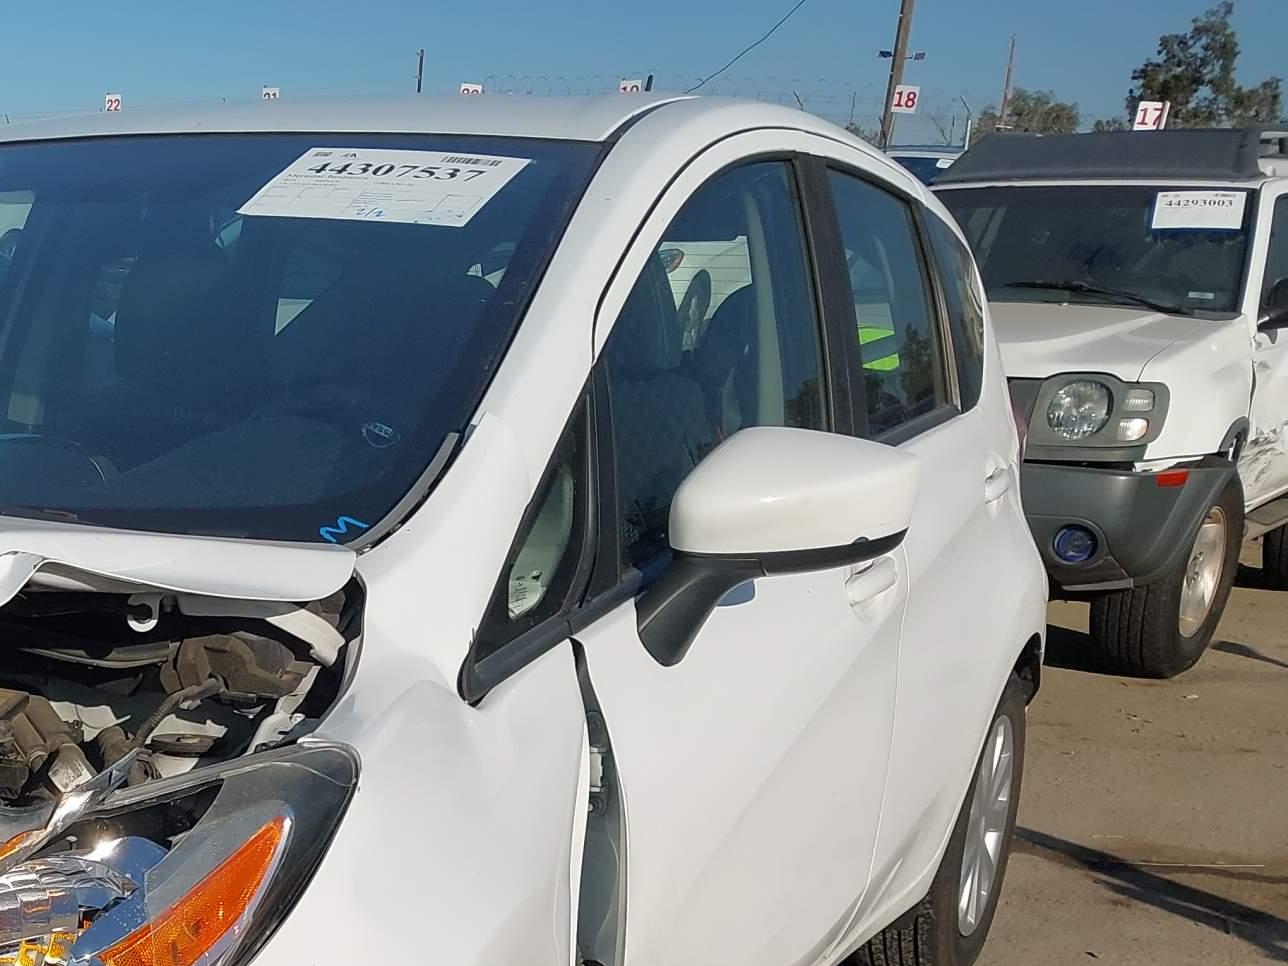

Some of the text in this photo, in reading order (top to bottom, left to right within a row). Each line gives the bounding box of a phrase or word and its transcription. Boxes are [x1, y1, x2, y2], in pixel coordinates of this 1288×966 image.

[107, 99, 120, 111] 22
[893, 91, 917, 108] 18
[1136, 107, 1162, 125] 17
[308, 161, 487, 182] 44307537
[1165, 199, 1233, 207] 44293003
